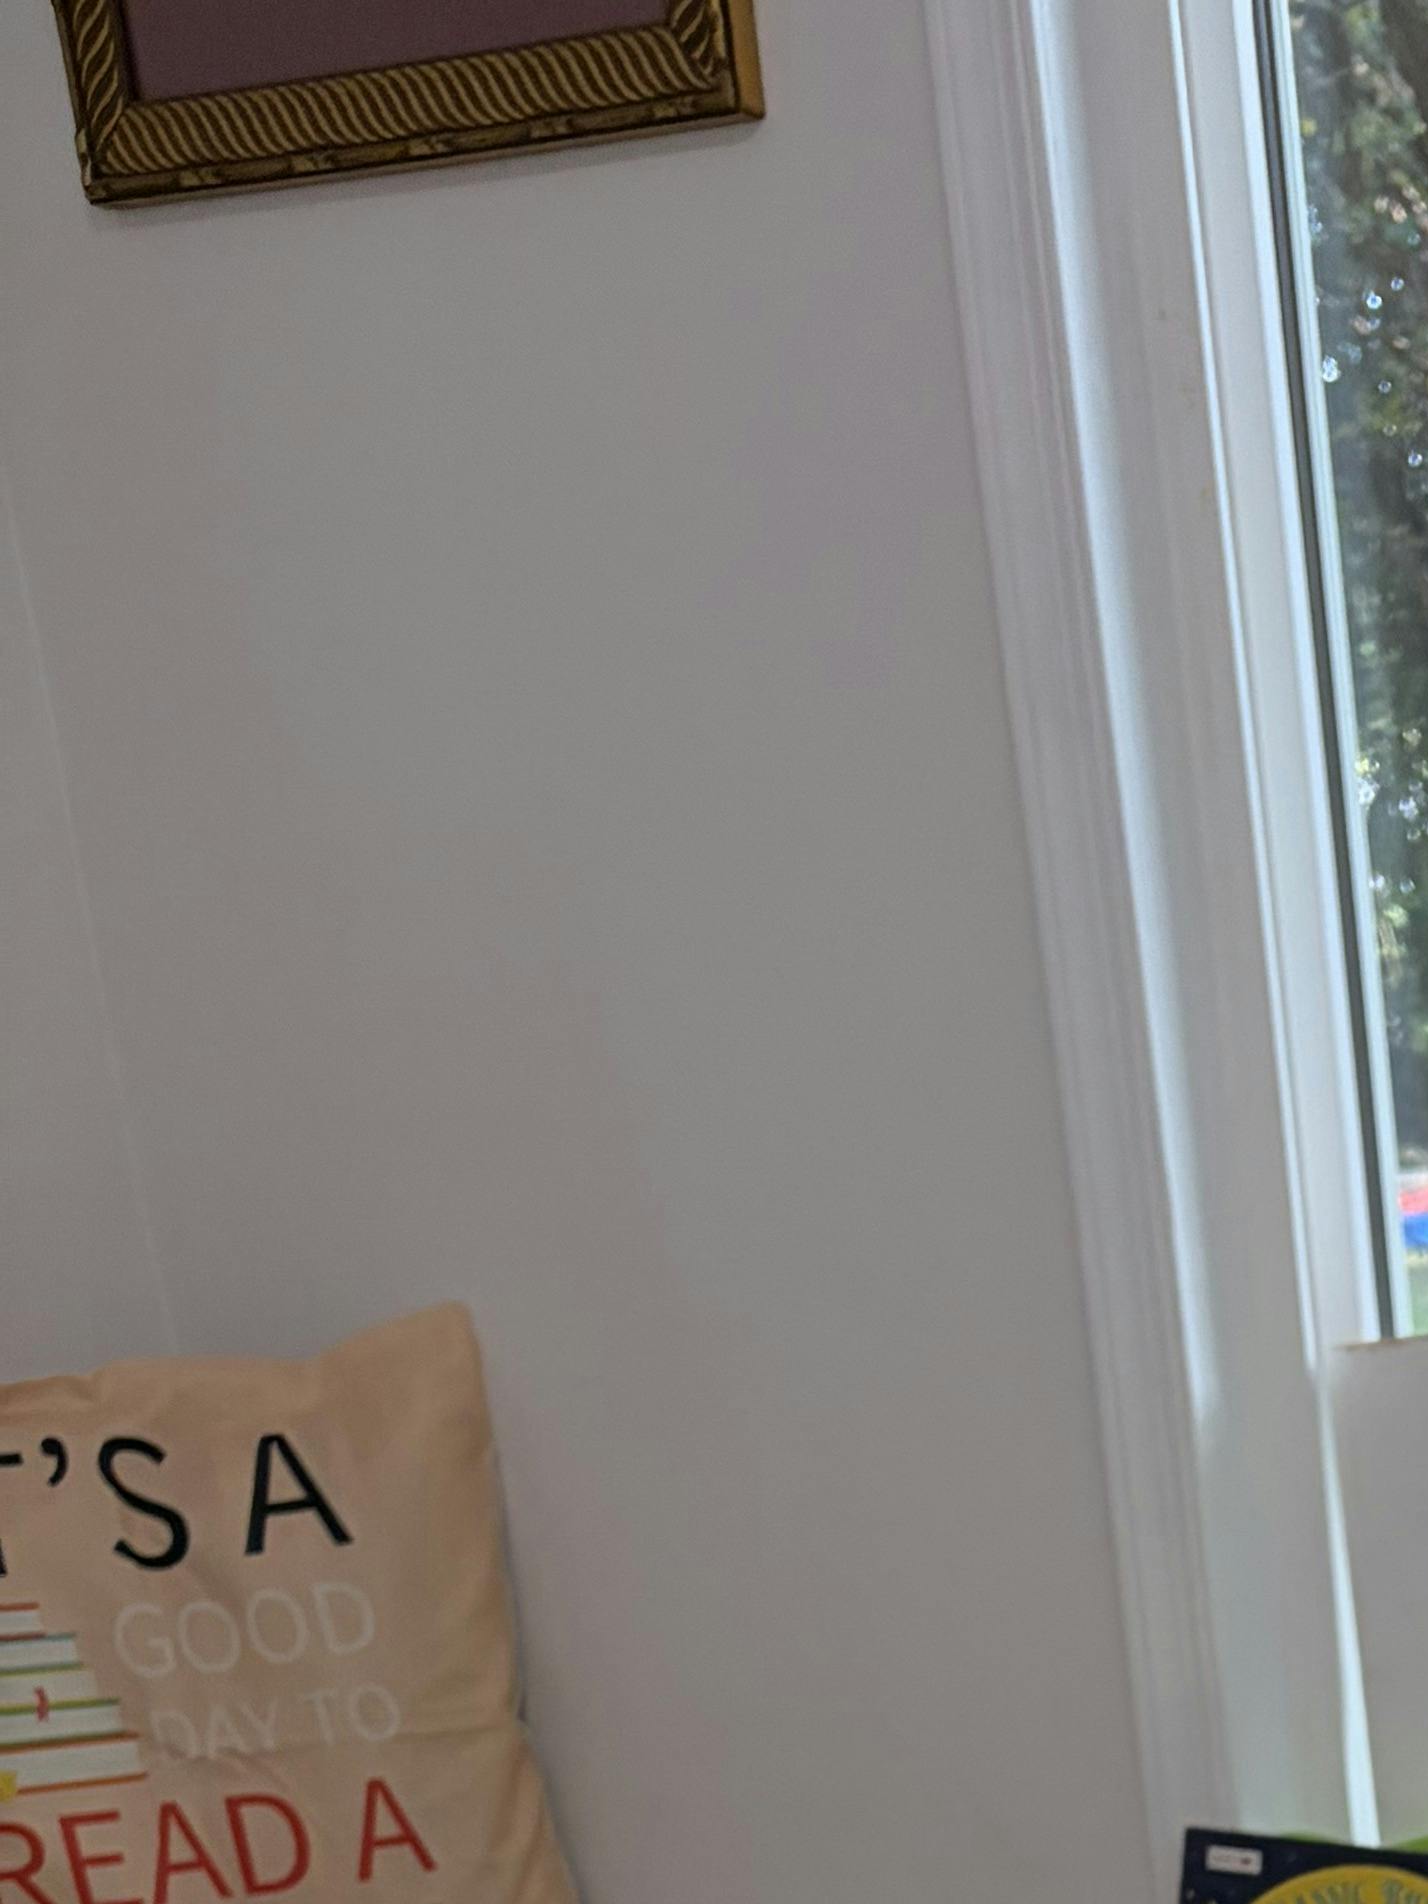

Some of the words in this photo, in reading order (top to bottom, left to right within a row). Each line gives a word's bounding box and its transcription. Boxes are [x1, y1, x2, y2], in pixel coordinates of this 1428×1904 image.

[244, 1433, 354, 1556] A
[113, 1580, 376, 1679] GOOD
[149, 1697, 279, 1759] DAY
[303, 1682, 401, 1746] TO
[357, 1776, 438, 1883] A
